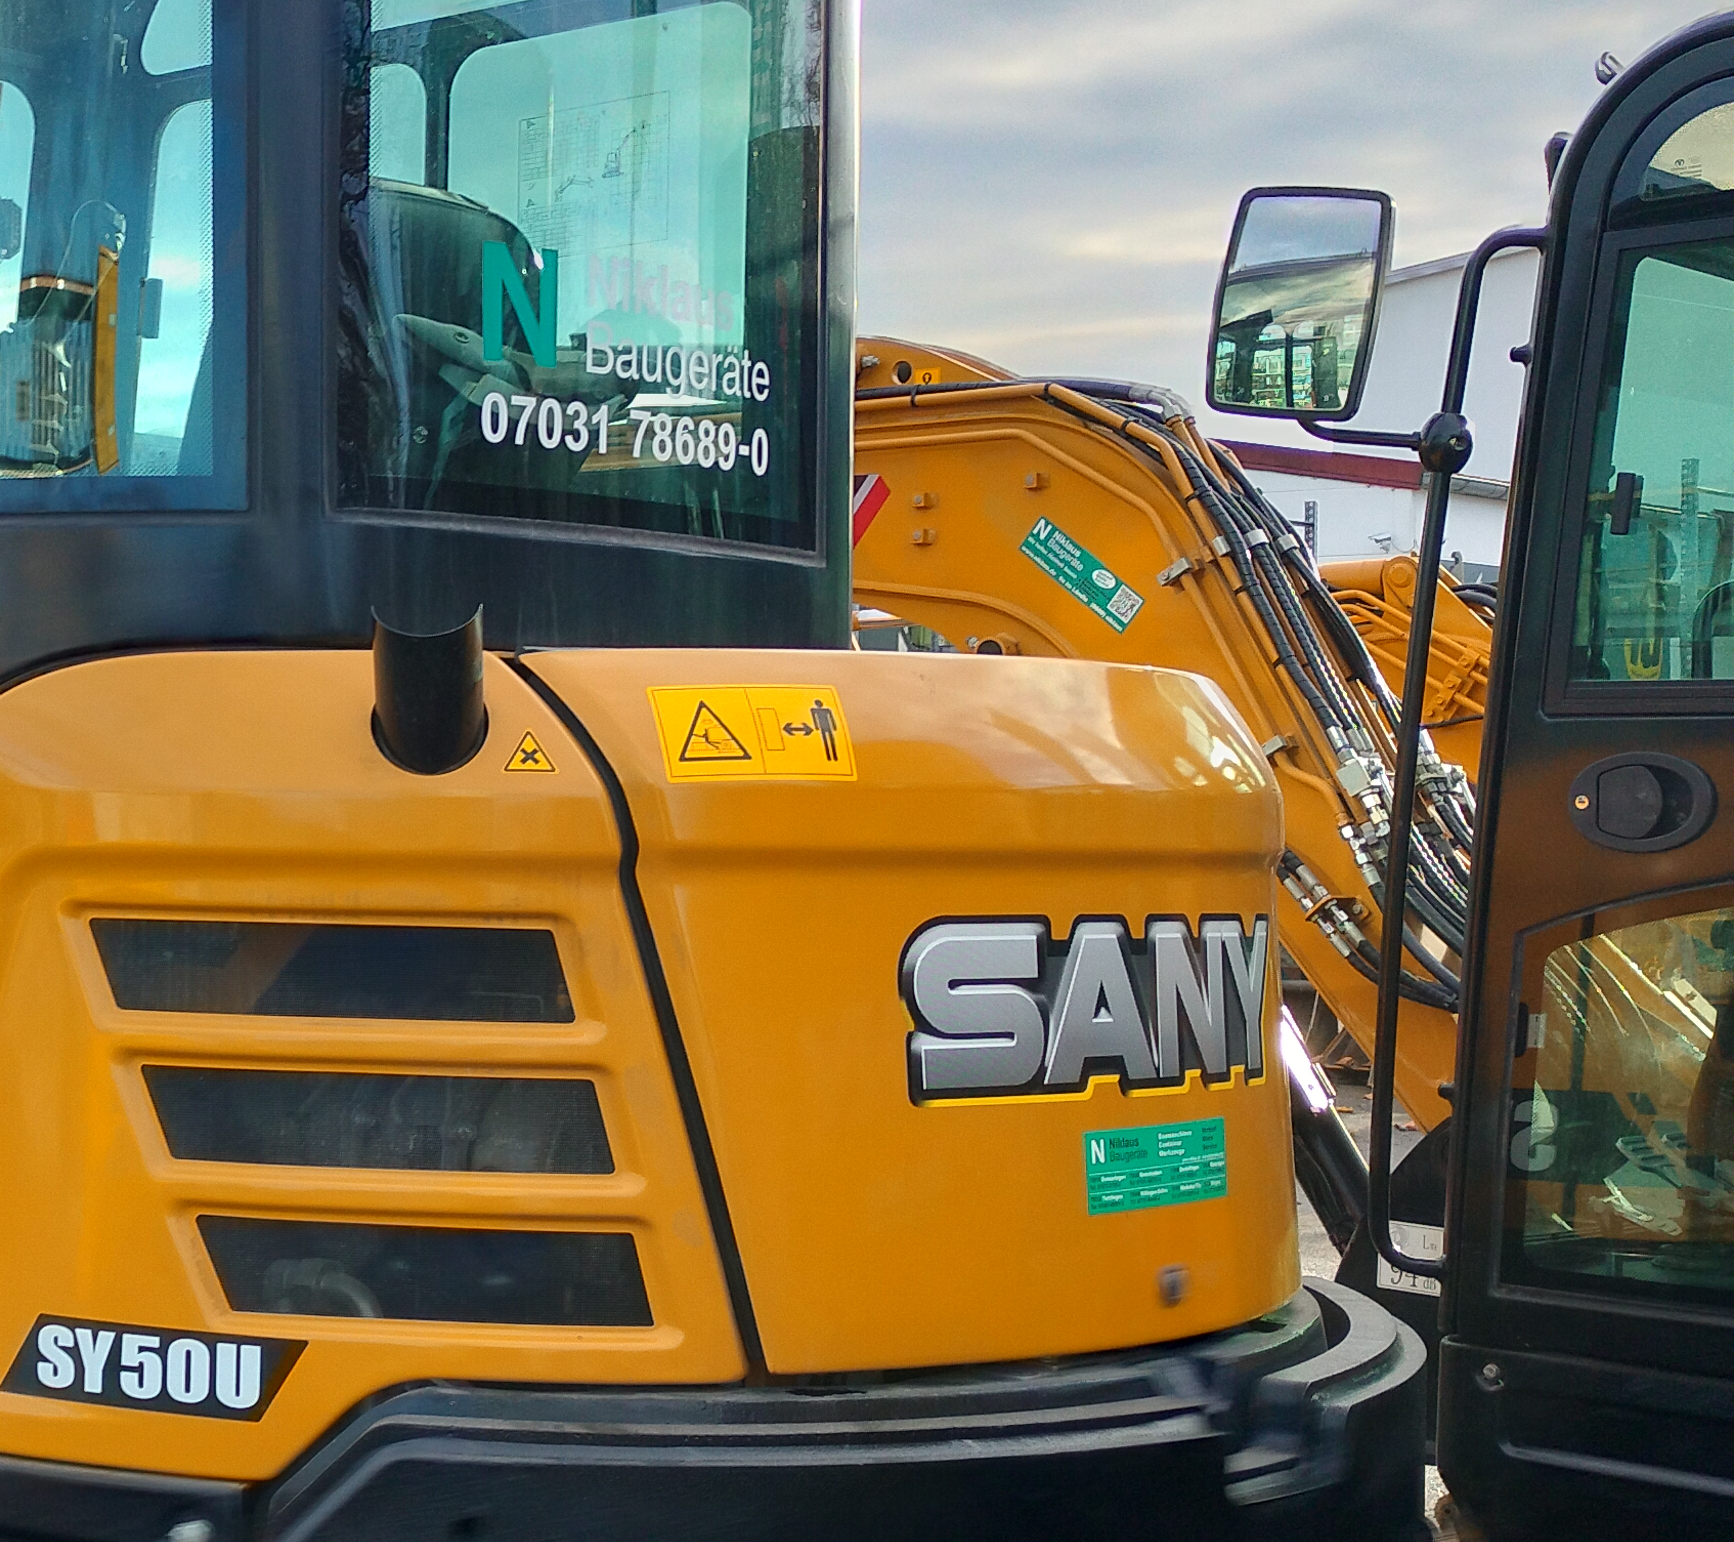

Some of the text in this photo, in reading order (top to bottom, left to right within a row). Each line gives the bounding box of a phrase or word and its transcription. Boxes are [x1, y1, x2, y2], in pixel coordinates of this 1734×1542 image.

[482, 240, 559, 368] N
[587, 254, 735, 332] Niklaus
[585, 320, 771, 402] Baugeräte
[481, 392, 770, 476] 07031 78689-0
[1032, 518, 1053, 541] N
[900, 916, 1268, 1093] SANY
[1090, 1138, 1106, 1164] N
[36, 1323, 261, 1409] SY50U
